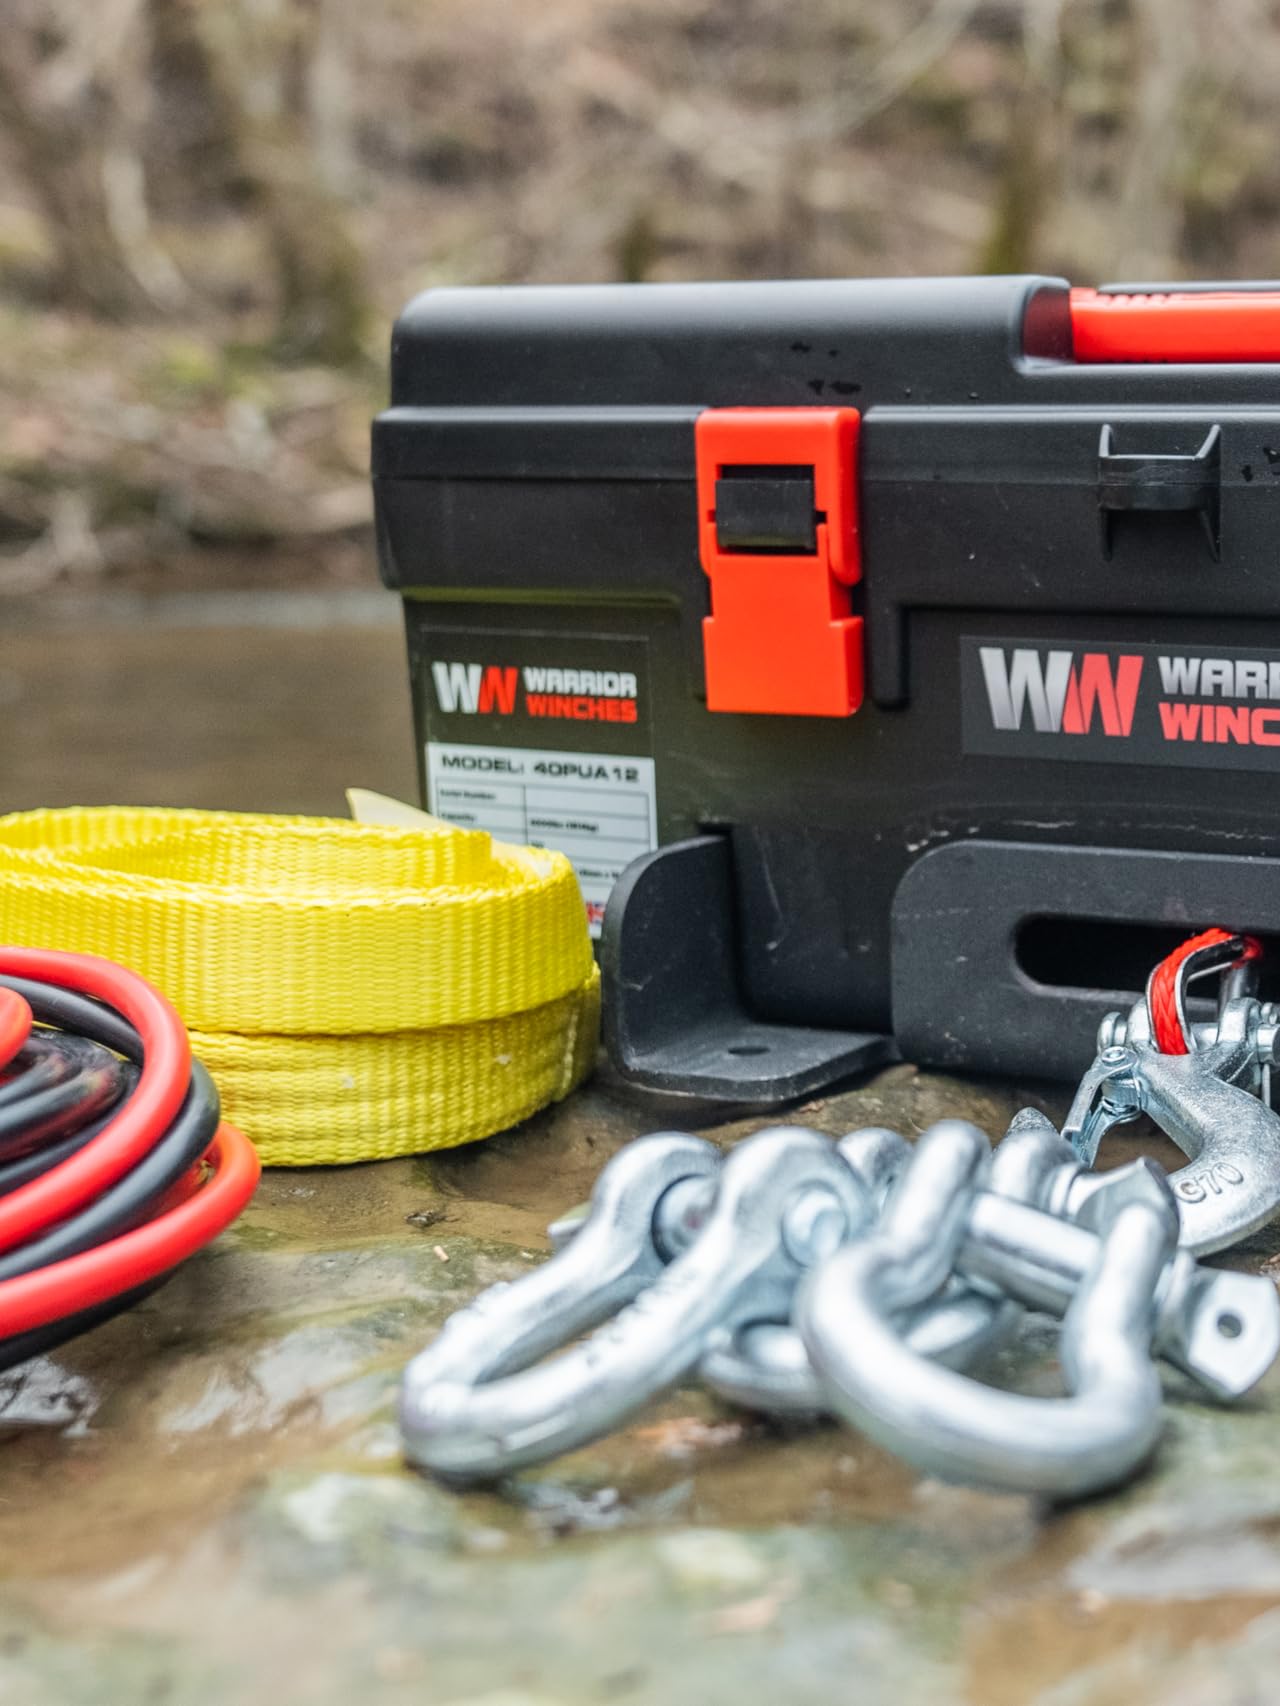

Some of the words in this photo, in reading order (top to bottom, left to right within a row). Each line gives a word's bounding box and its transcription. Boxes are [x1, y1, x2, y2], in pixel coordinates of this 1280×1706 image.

[523, 666, 638, 698] WARRIOR
[526, 694, 638, 724] WINCHES
[442, 755, 525, 775] MODEL:
[1173, 1161, 1244, 1204] G70
